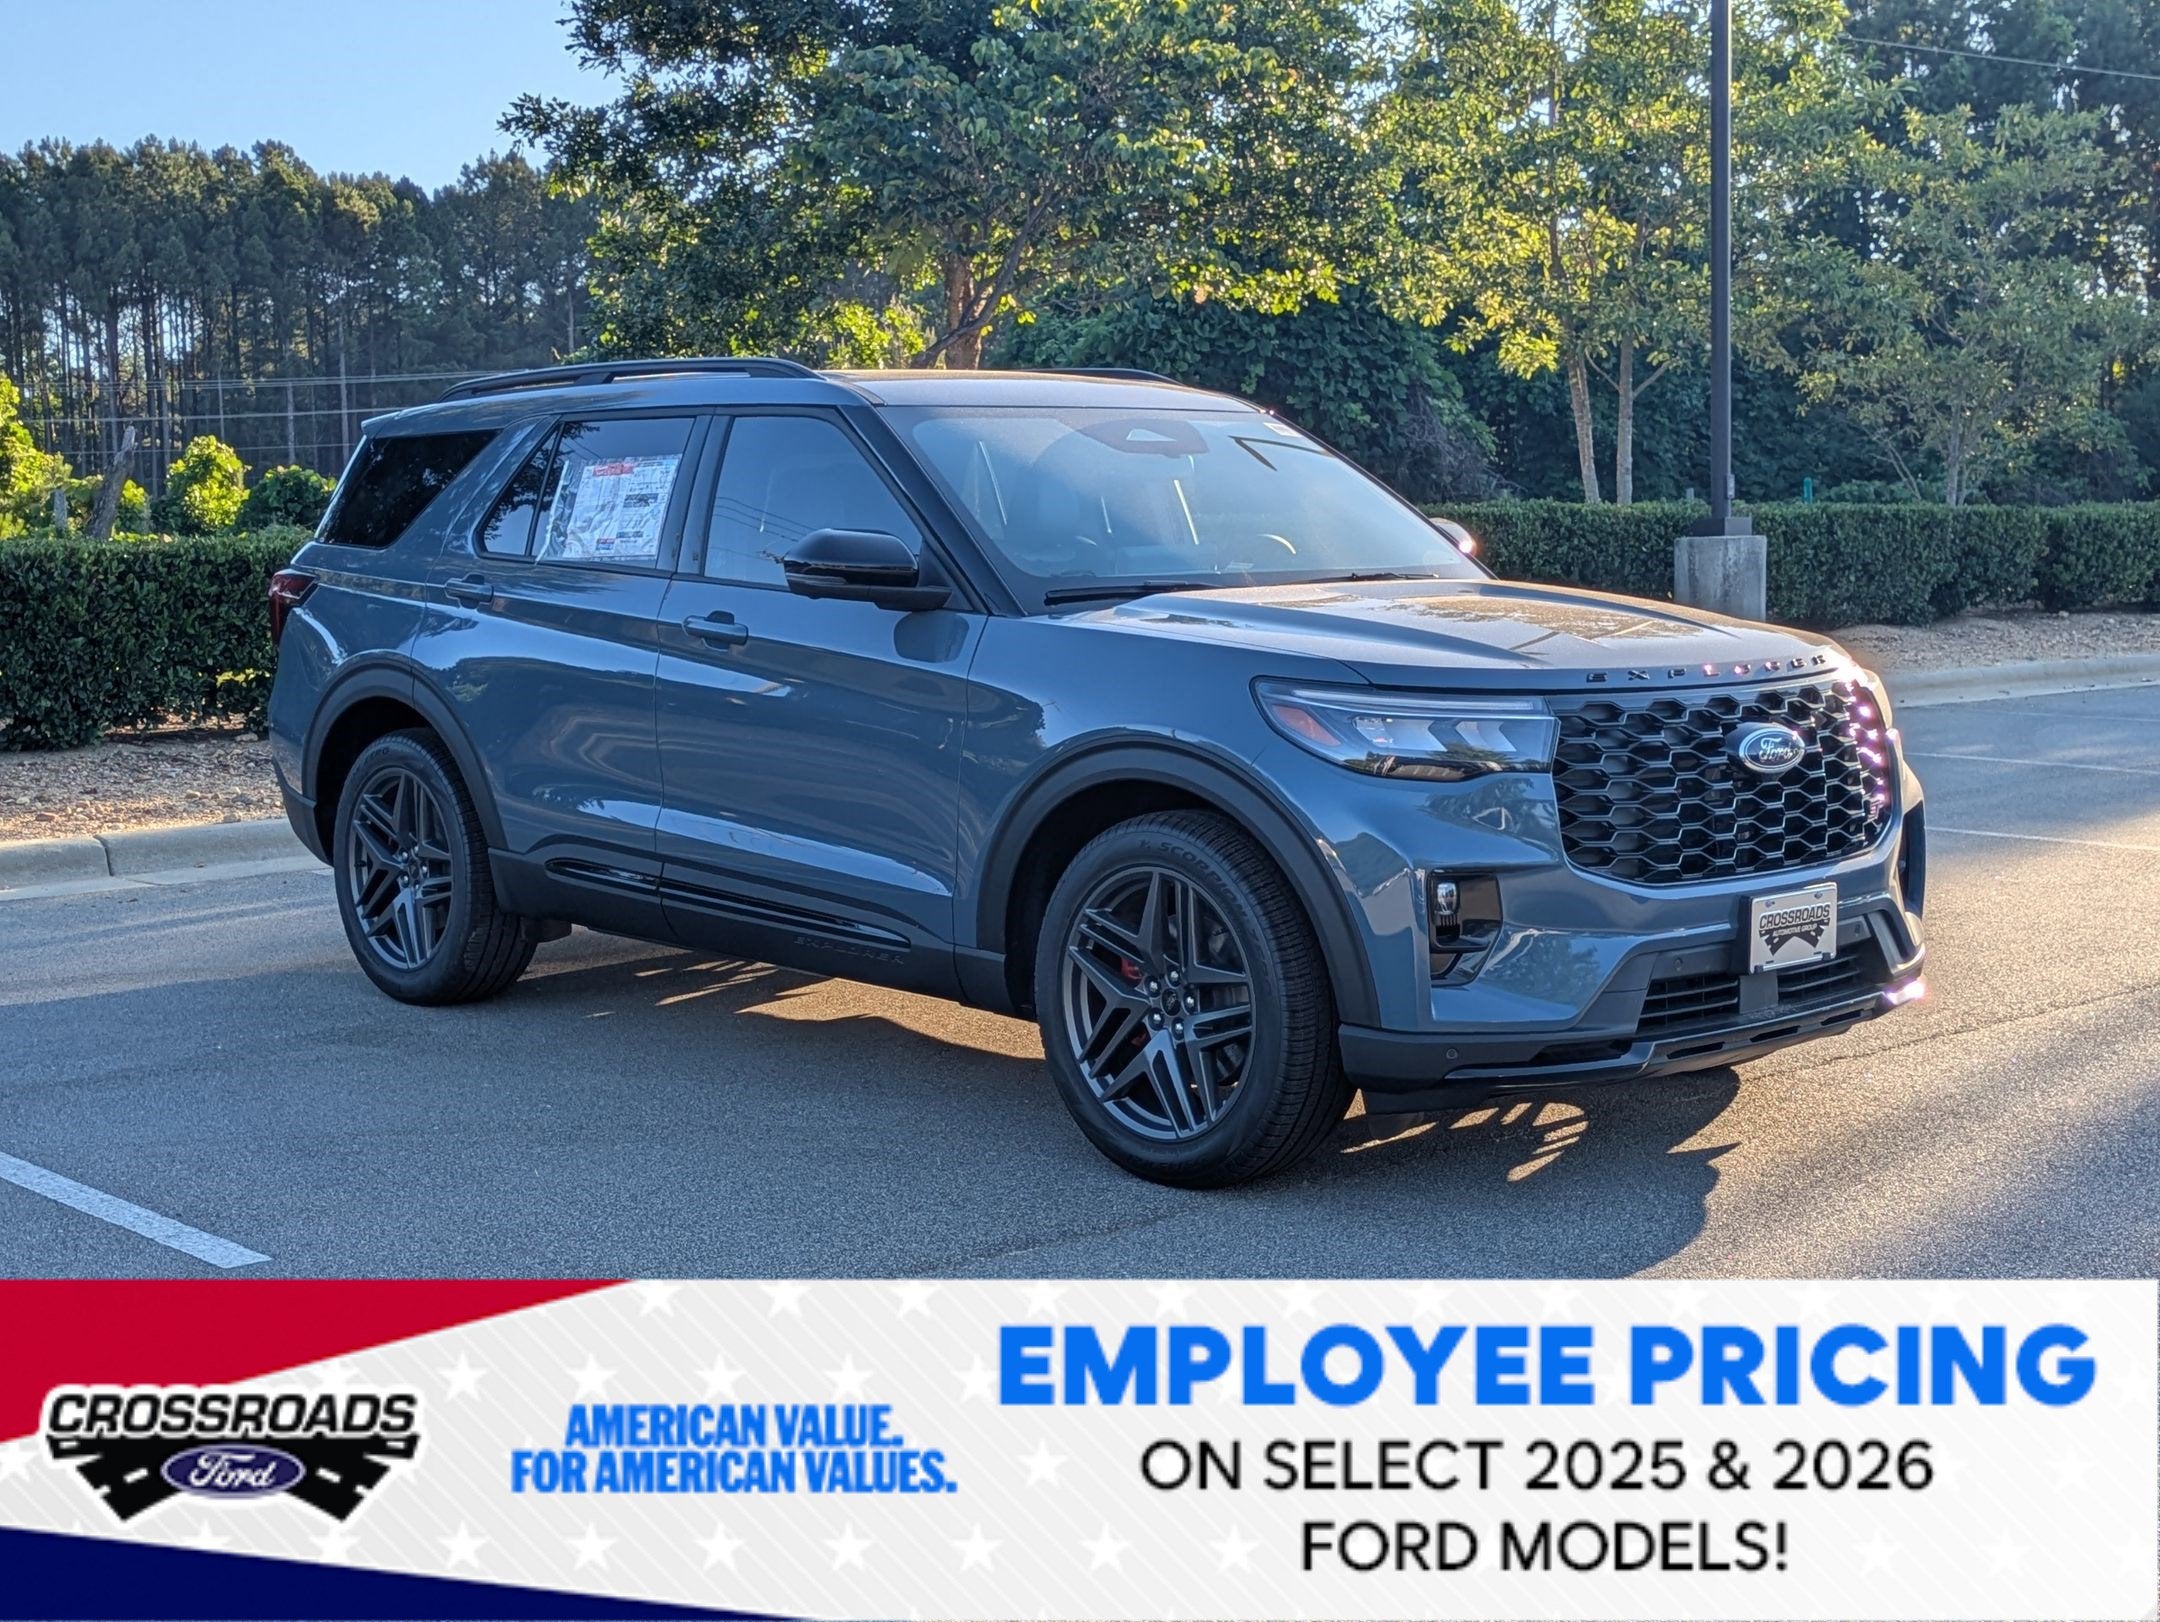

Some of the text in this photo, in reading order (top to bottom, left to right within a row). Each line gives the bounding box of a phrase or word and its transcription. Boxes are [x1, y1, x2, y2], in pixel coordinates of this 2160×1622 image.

[1586, 654, 1827, 683] EXPLORER
[1759, 737, 1797, 760] Ford
[1760, 904, 1831, 929] CROSSROADS
